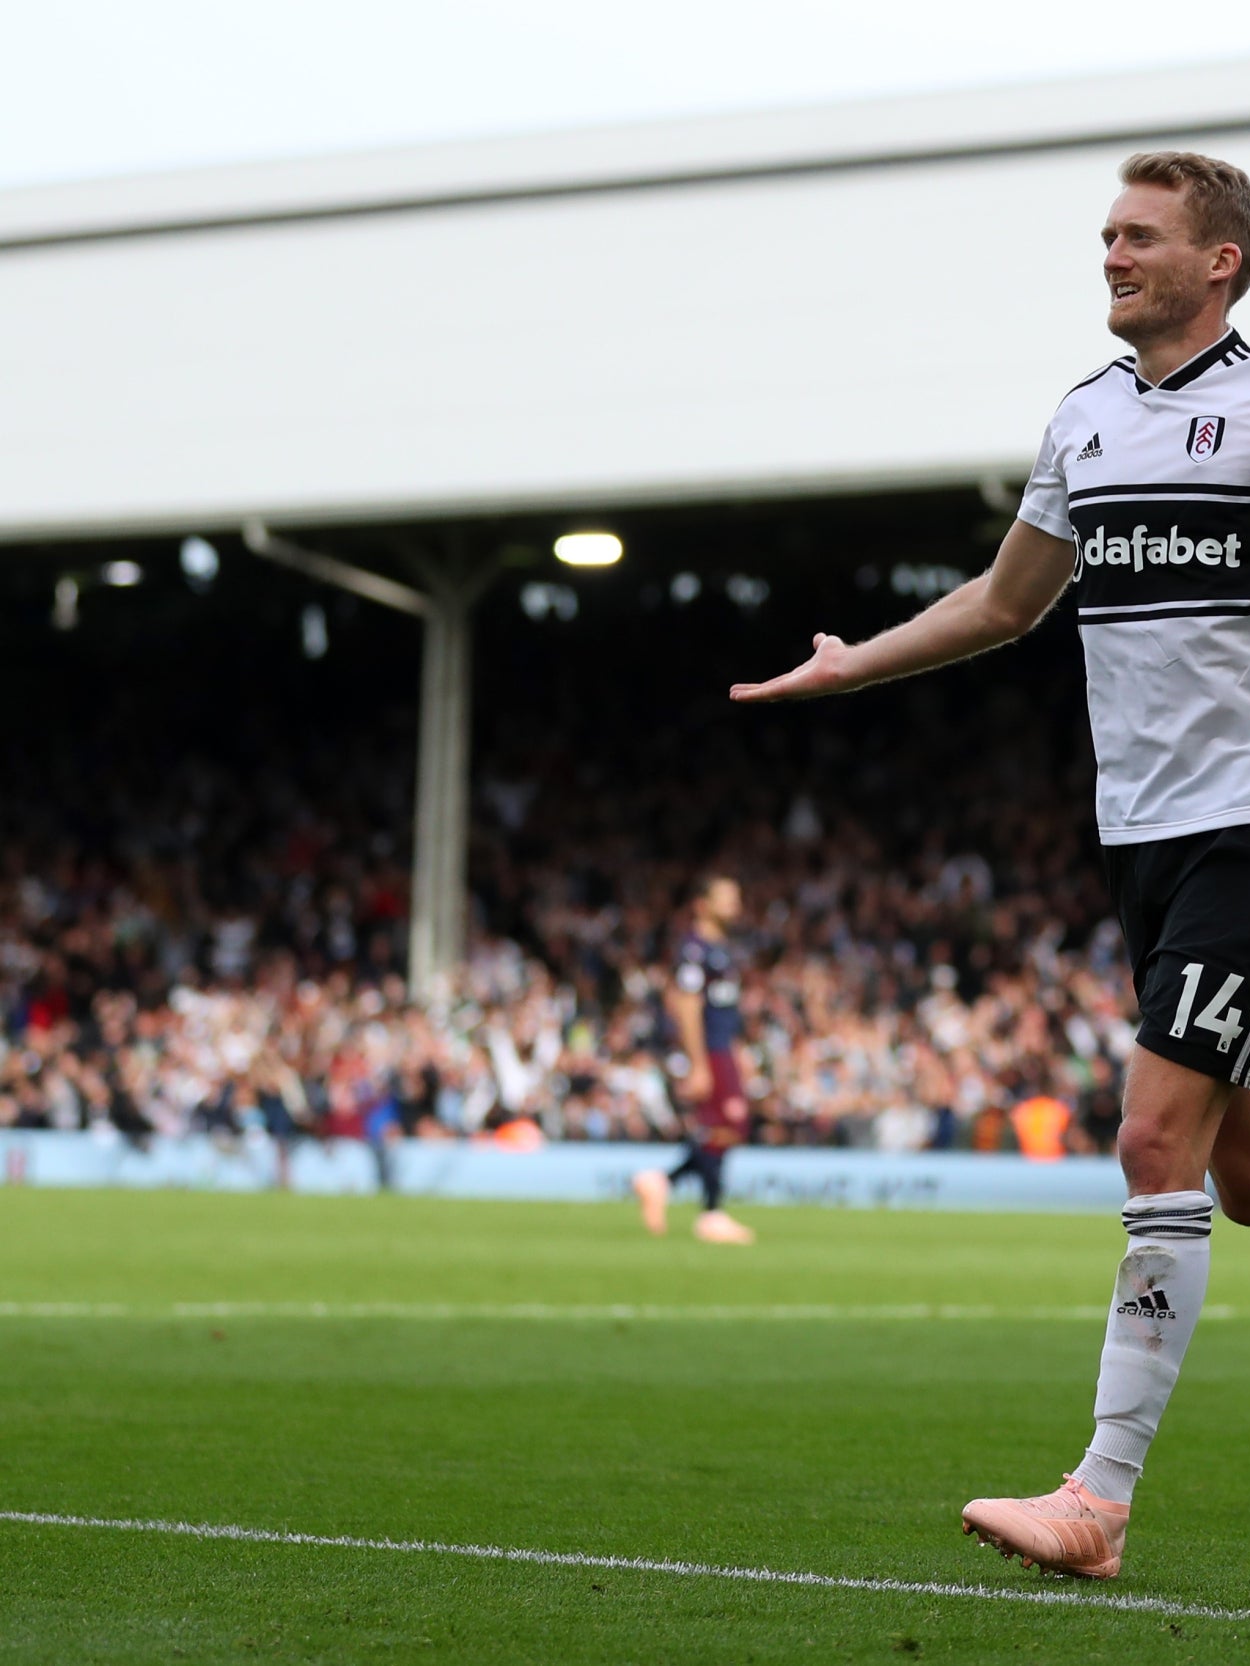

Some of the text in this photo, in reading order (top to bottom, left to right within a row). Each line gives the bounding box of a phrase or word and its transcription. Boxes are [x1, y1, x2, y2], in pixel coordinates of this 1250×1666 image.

[1076, 448, 1104, 462] adidas
[1084, 524, 1241, 572] dafabet
[1168, 962, 1246, 1054] 14
[1116, 1305, 1177, 1320] adidas
